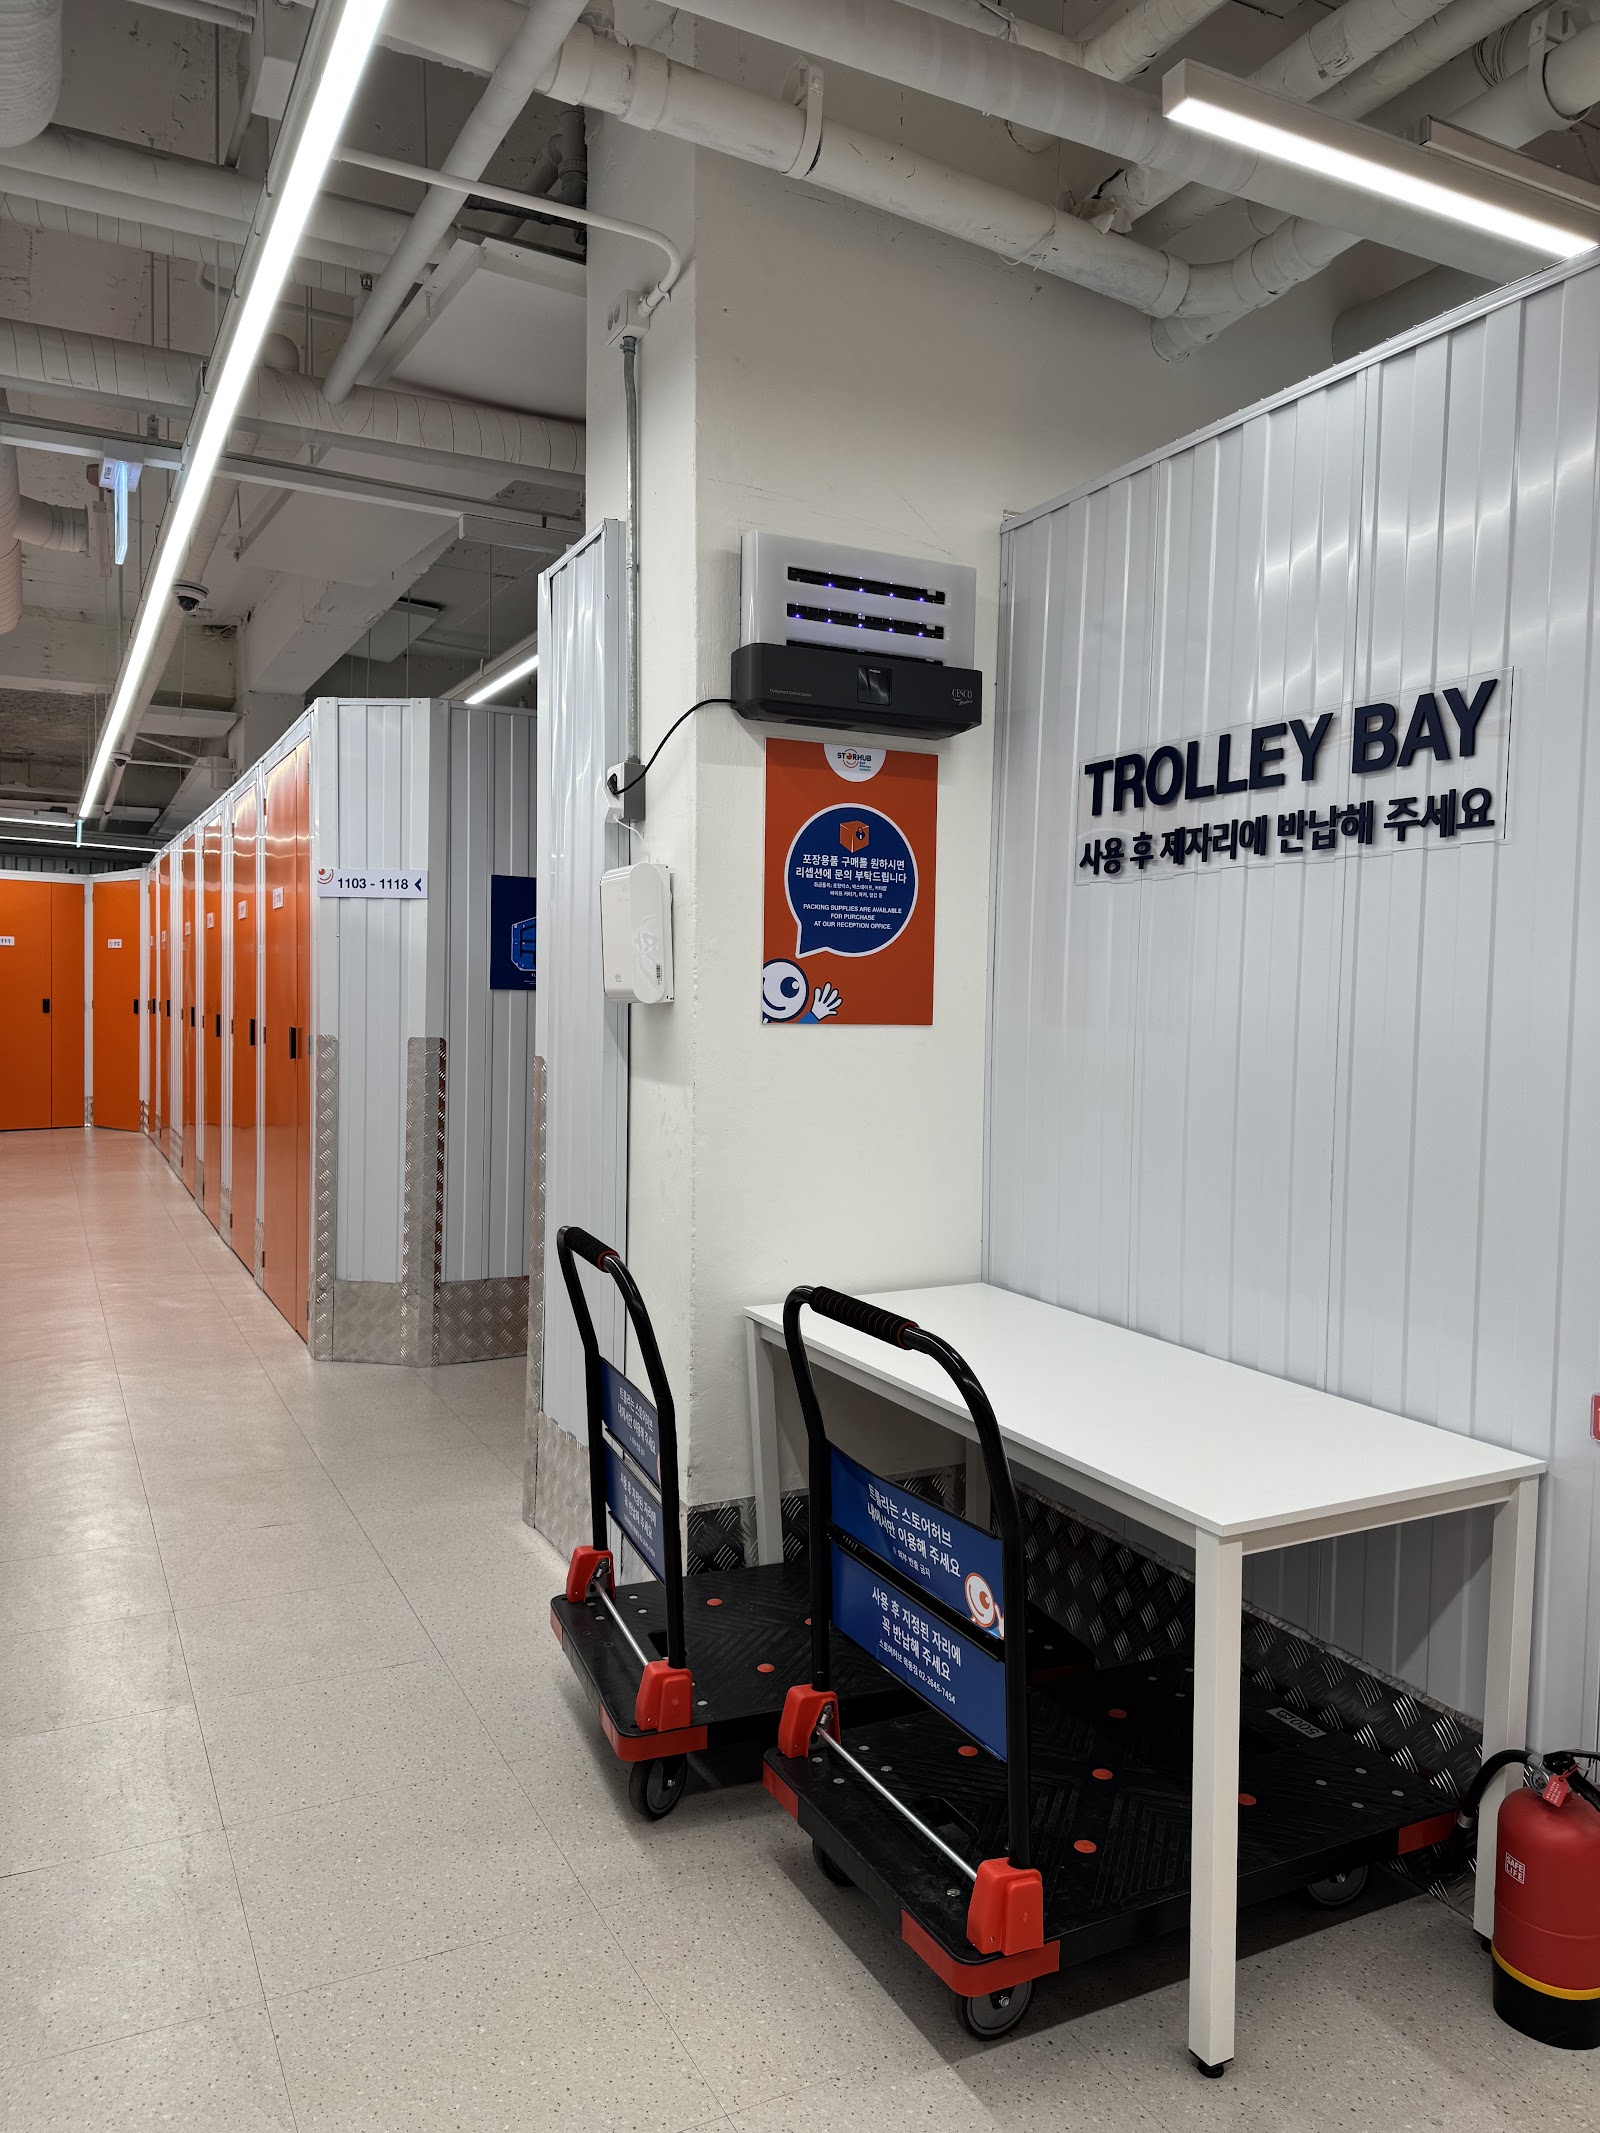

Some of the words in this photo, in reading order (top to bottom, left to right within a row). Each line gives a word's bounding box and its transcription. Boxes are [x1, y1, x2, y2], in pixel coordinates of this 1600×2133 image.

[952, 688, 973, 699] CESCO
[1084, 712, 1333, 816] TROLLEY
[1351, 678, 1497, 774] BAY
[1079, 840, 1124, 876] 사용
[1130, 831, 1154, 869] 후
[1159, 815, 1267, 865] 제자리에
[1277, 800, 1374, 853] 반납해
[1384, 787, 1495, 842] 주세요
[802, 854, 838, 867] 포장용품
[841, 856, 868, 869] 구매를
[870, 858, 905, 871] 원하시면
[338, 878, 367, 889] 1103
[379, 878, 409, 890] 1118
[795, 867, 832, 879] 리셉션에
[834, 869, 852, 881] 문의
[855, 871, 907, 884] 부탁드립니다
[830, 904, 859, 912] SUPPLIES
[872, 906, 902, 914] AVAILABLE
[843, 913, 875, 921] PURCHASE
[867, 1483, 899, 1519] 트롤리는
[901, 1507, 953, 1548] 스토어허브
[867, 1502, 896, 1539] 내에서만
[897, 1527, 927, 1559] 이용해
[929, 1545, 961, 1578] 주세요
[872, 1586, 888, 1612] 사용
[891, 1599, 900, 1619] 후
[902, 1608, 929, 1643] 지정된
[931, 1630, 961, 1667] 자리에
[882, 1615, 891, 1637] 꼭
[893, 1624, 920, 1659] 반납해
[922, 1646, 951, 1681] 주세요
[879, 1639, 902, 1663] 스토어허브
[918, 1669, 956, 1705] 02-2645-7454
[1290, 1719, 1319, 1735] 500
[1506, 1856, 1524, 1873] SAFE
[1506, 1863, 1523, 1882] LIFE
